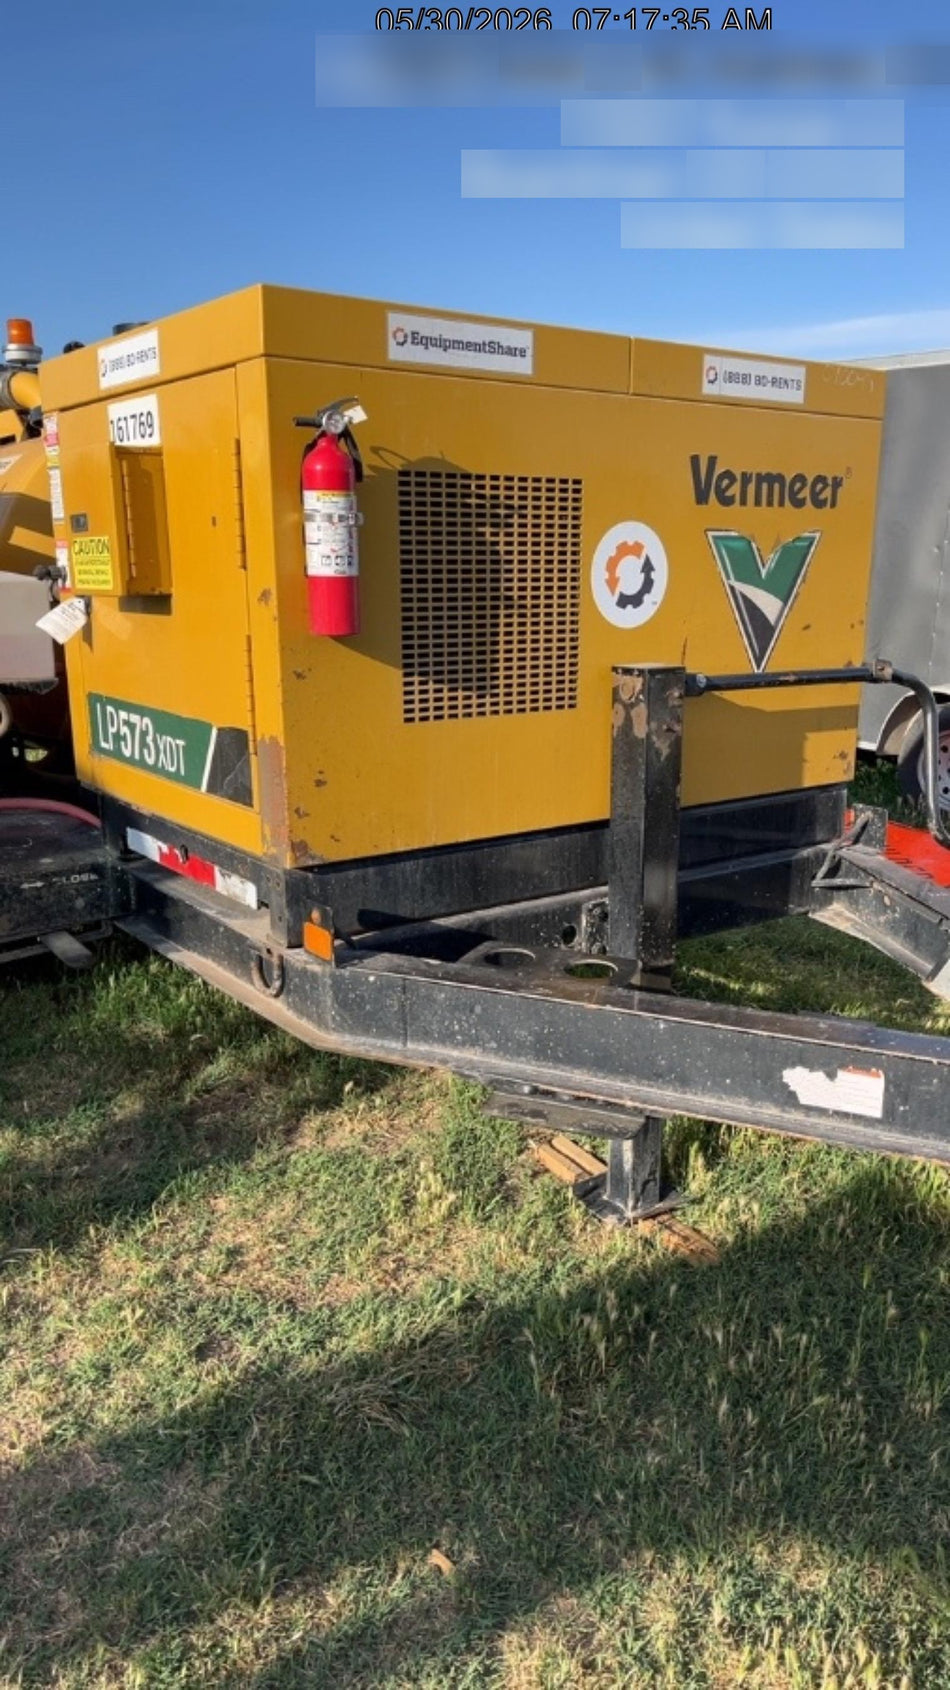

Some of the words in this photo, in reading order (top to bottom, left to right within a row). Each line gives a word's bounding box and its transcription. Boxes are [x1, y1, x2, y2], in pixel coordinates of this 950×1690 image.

[410, 330, 527, 358] EquipmentShare
[722, 368, 752, 385] (888)
[110, 410, 155, 443] 161769
[689, 454, 844, 509] Vermeer
[73, 538, 110, 555] CAUTION
